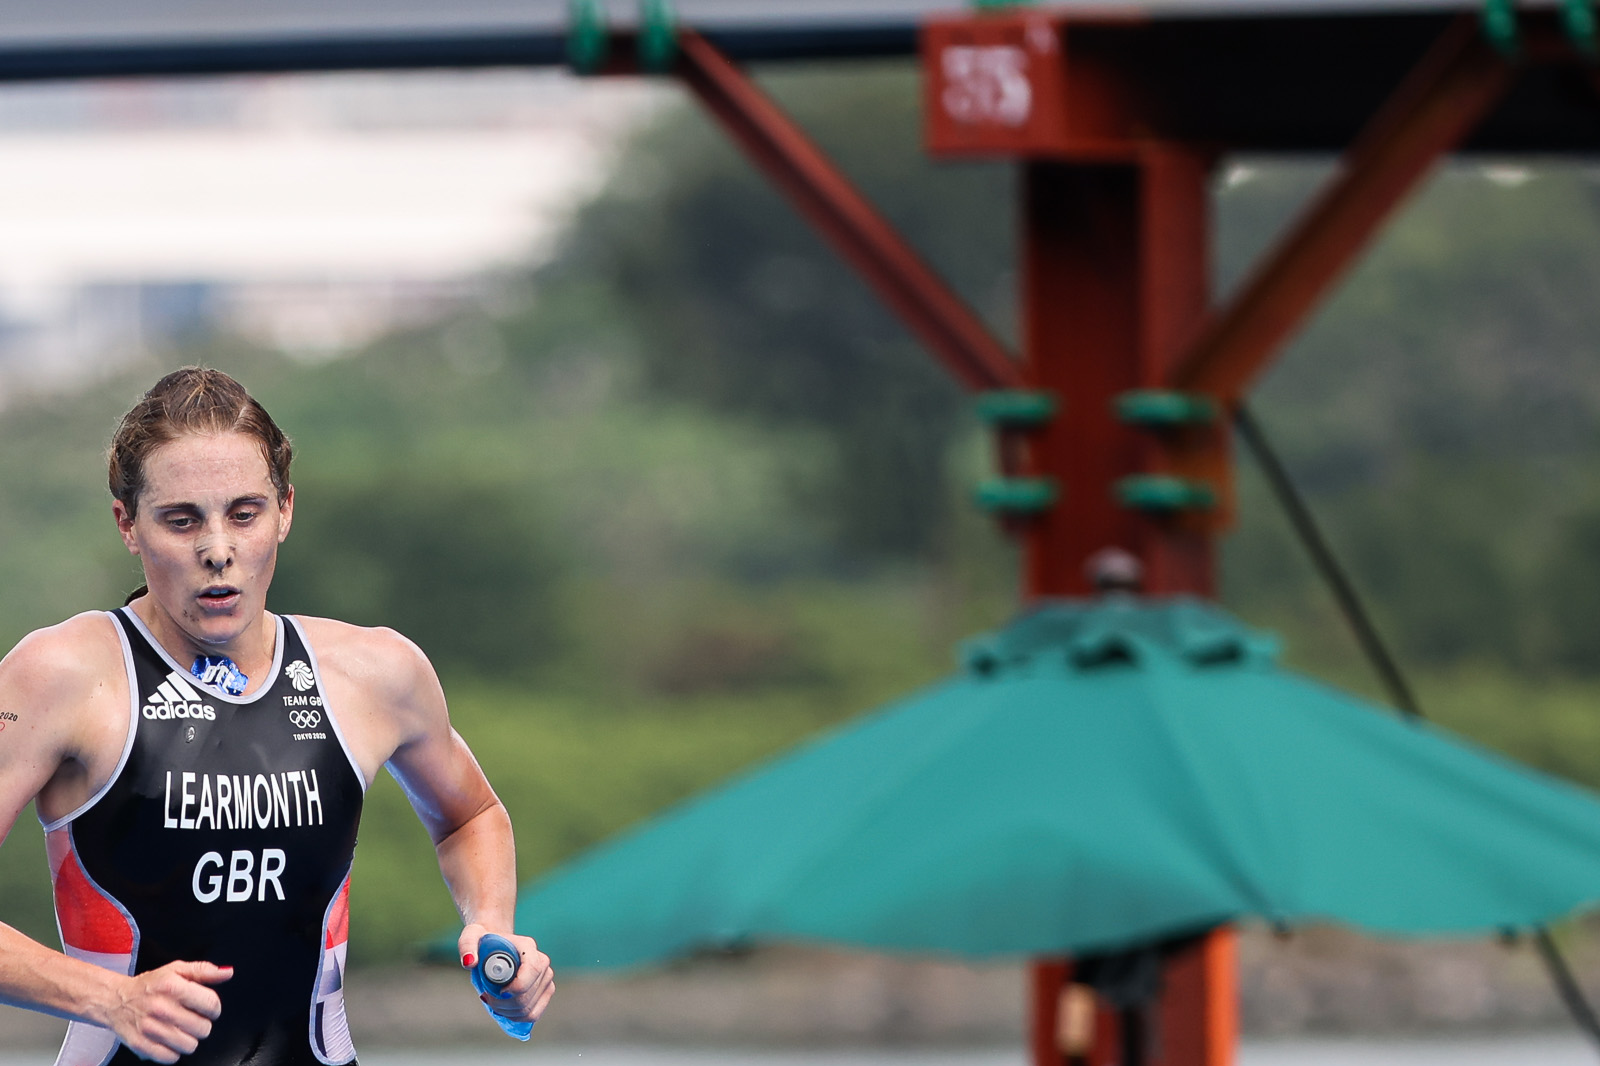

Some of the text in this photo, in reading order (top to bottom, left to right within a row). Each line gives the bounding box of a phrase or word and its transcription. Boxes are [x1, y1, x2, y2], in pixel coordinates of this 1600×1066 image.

[142, 700, 216, 721] adidas
[283, 695, 323, 707] TEAM GB
[292, 732, 327, 741] TOKYO 2020
[164, 769, 323, 829] LEARMONTH
[192, 848, 286, 903] GBR
